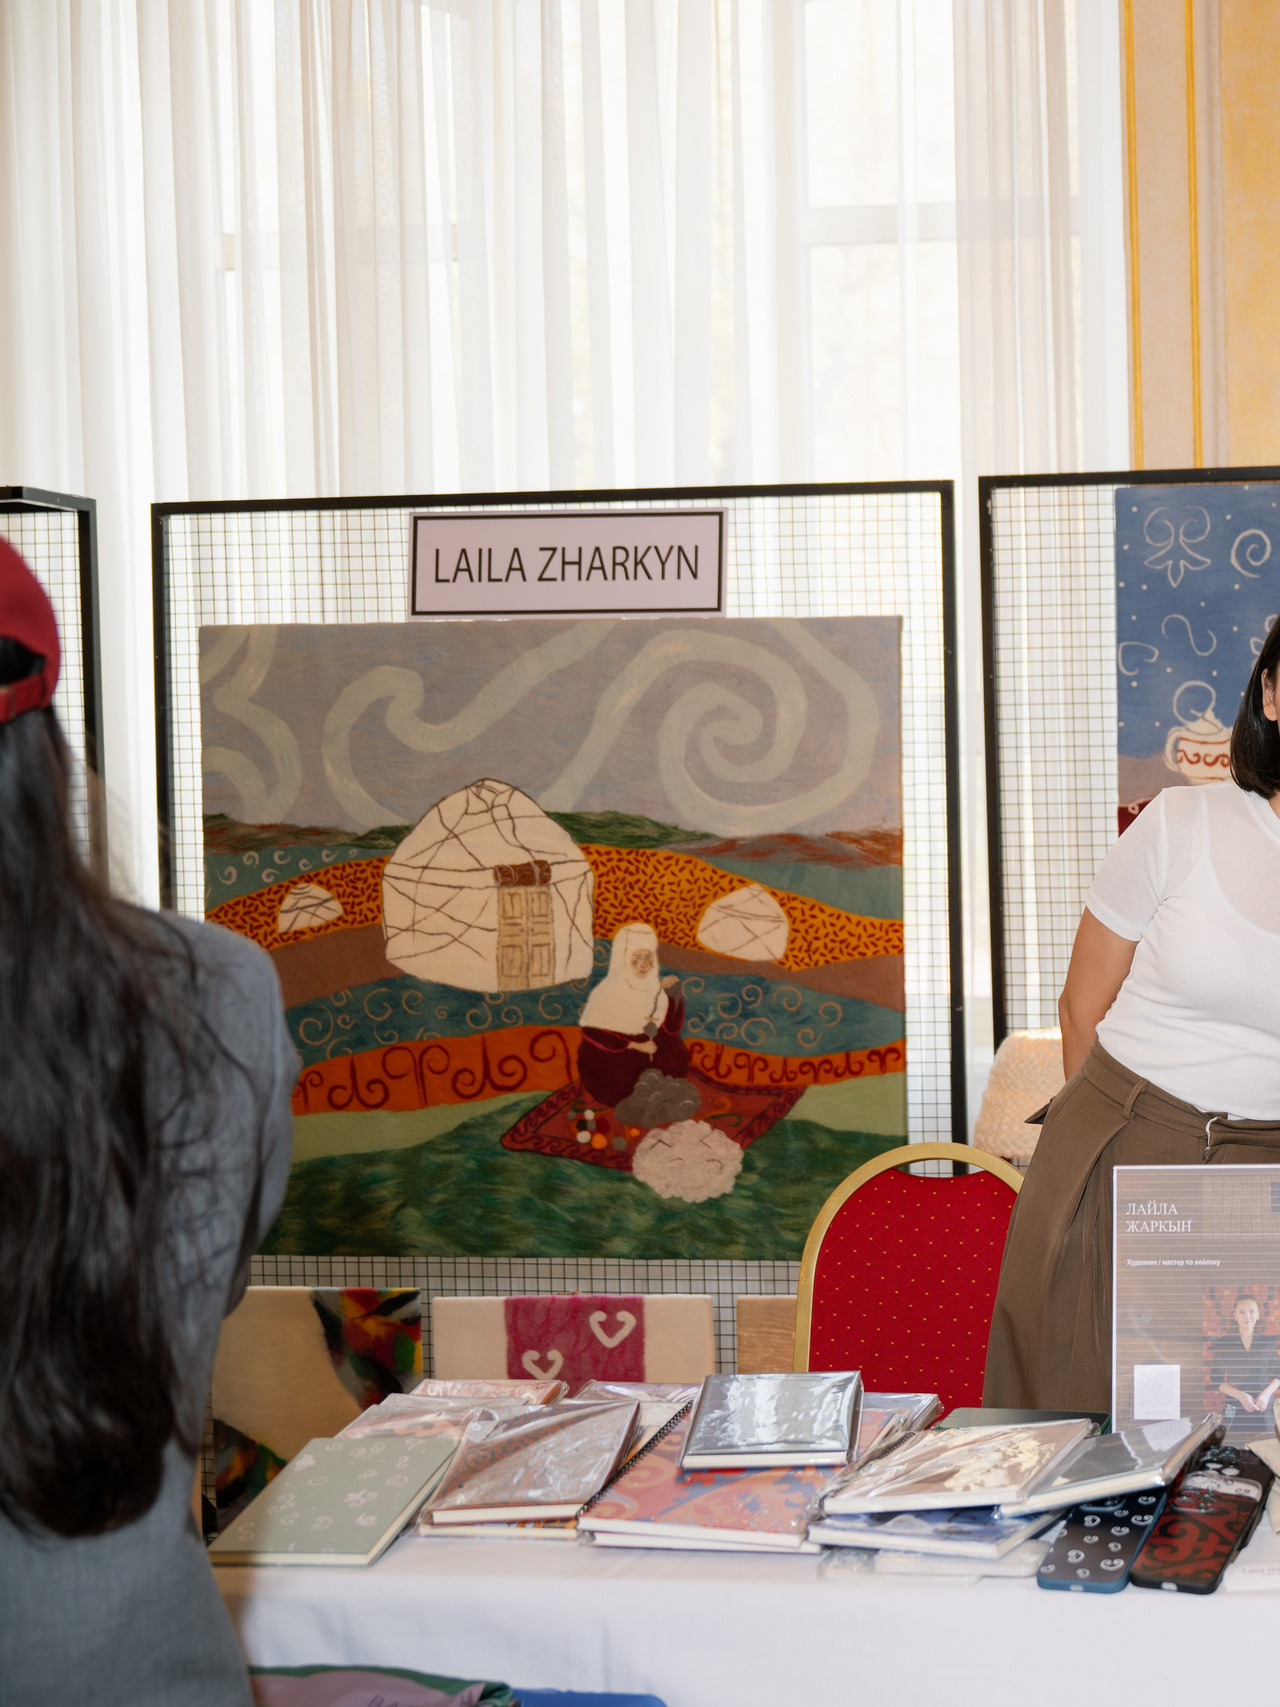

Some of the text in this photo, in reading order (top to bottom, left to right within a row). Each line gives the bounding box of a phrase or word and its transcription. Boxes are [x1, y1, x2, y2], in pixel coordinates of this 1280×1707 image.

[435, 545, 699, 583] LAILA ZHARKYN
[1126, 1200, 1178, 1215] ЛАЙЛА
[1126, 1220, 1192, 1232] ЖАРКЫН
[1162, 1259, 1184, 1267] мастер
